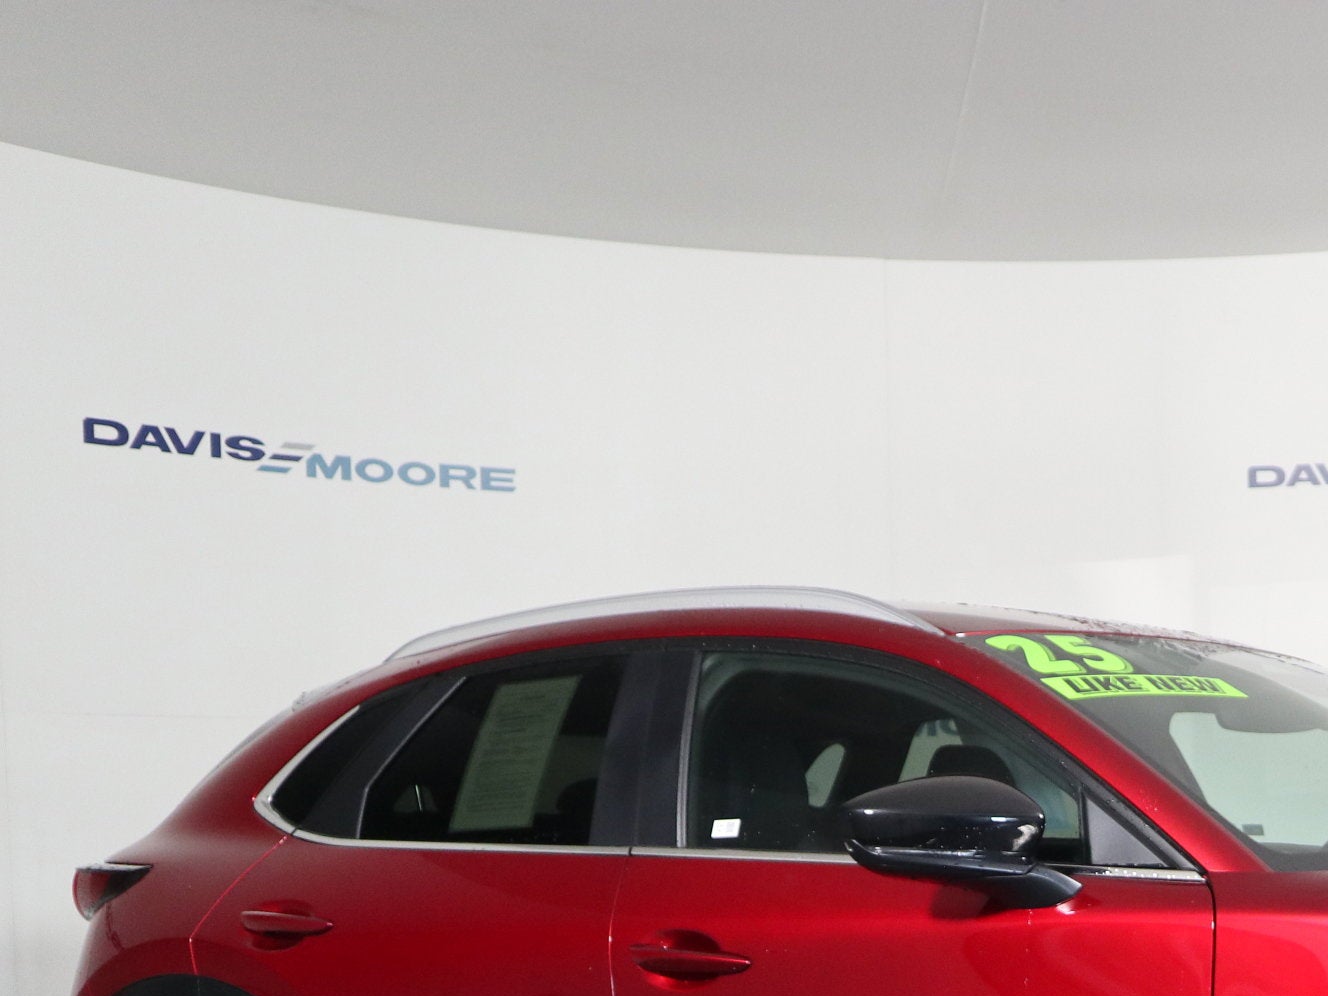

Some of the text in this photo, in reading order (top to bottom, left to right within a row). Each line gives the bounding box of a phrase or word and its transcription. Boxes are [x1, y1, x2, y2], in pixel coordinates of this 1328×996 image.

[82, 416, 516, 492] DAVIS MOORE
[985, 635, 1134, 675] 25
[1062, 675, 1226, 694] LIKE NEW
